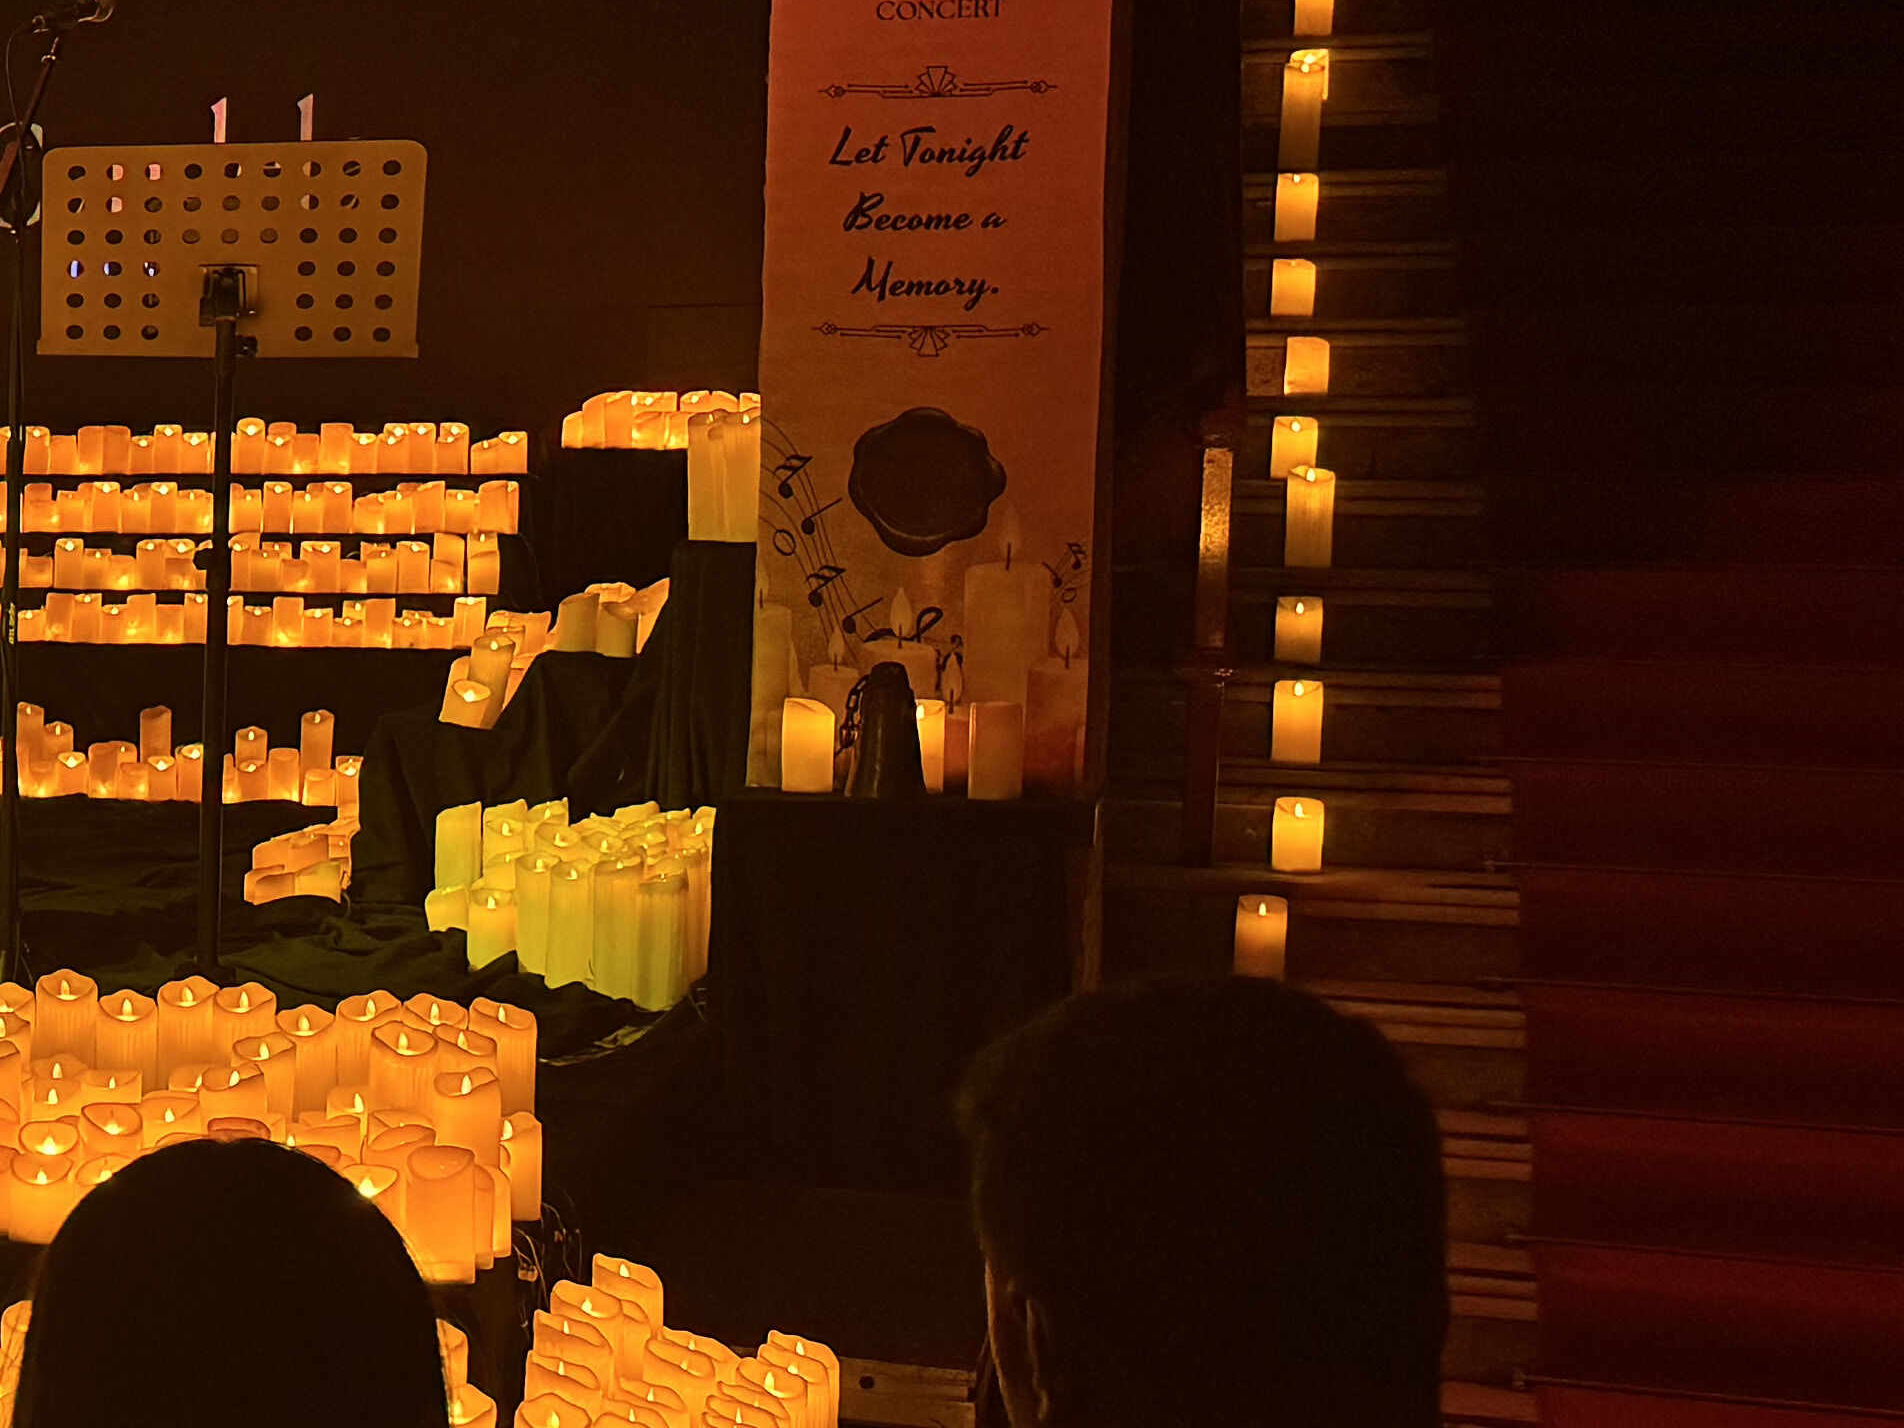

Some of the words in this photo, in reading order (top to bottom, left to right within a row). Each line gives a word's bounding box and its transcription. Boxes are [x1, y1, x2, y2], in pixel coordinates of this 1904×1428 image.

[829, 125, 890, 166] Let
[900, 124, 1030, 177] Tonight
[843, 192, 973, 232] Become
[981, 212, 1007, 229] a
[851, 255, 1000, 312] Memory.
